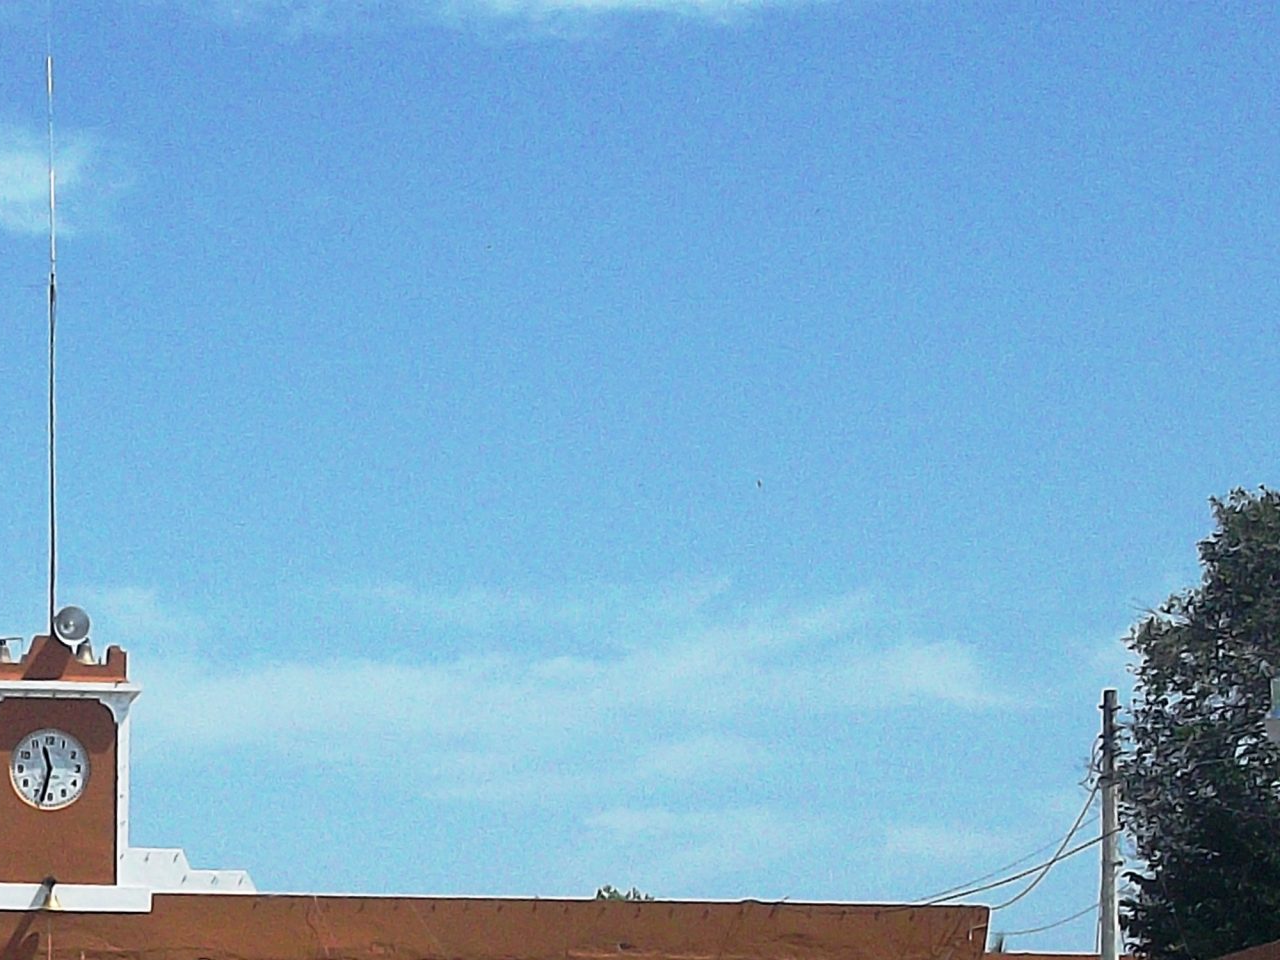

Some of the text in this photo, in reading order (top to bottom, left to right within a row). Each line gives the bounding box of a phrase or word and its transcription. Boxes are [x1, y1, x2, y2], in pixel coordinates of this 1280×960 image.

[32, 739, 39, 748] 11
[45, 735, 55, 745] 12
[20, 750, 31, 760] 10
[70, 751, 76, 759] 2
[17, 764, 24, 773] 9
[74, 764, 81, 773] 3
[71, 779, 77, 787] 4
[34, 788, 40, 798] 7
[47, 792, 53, 801] 6
